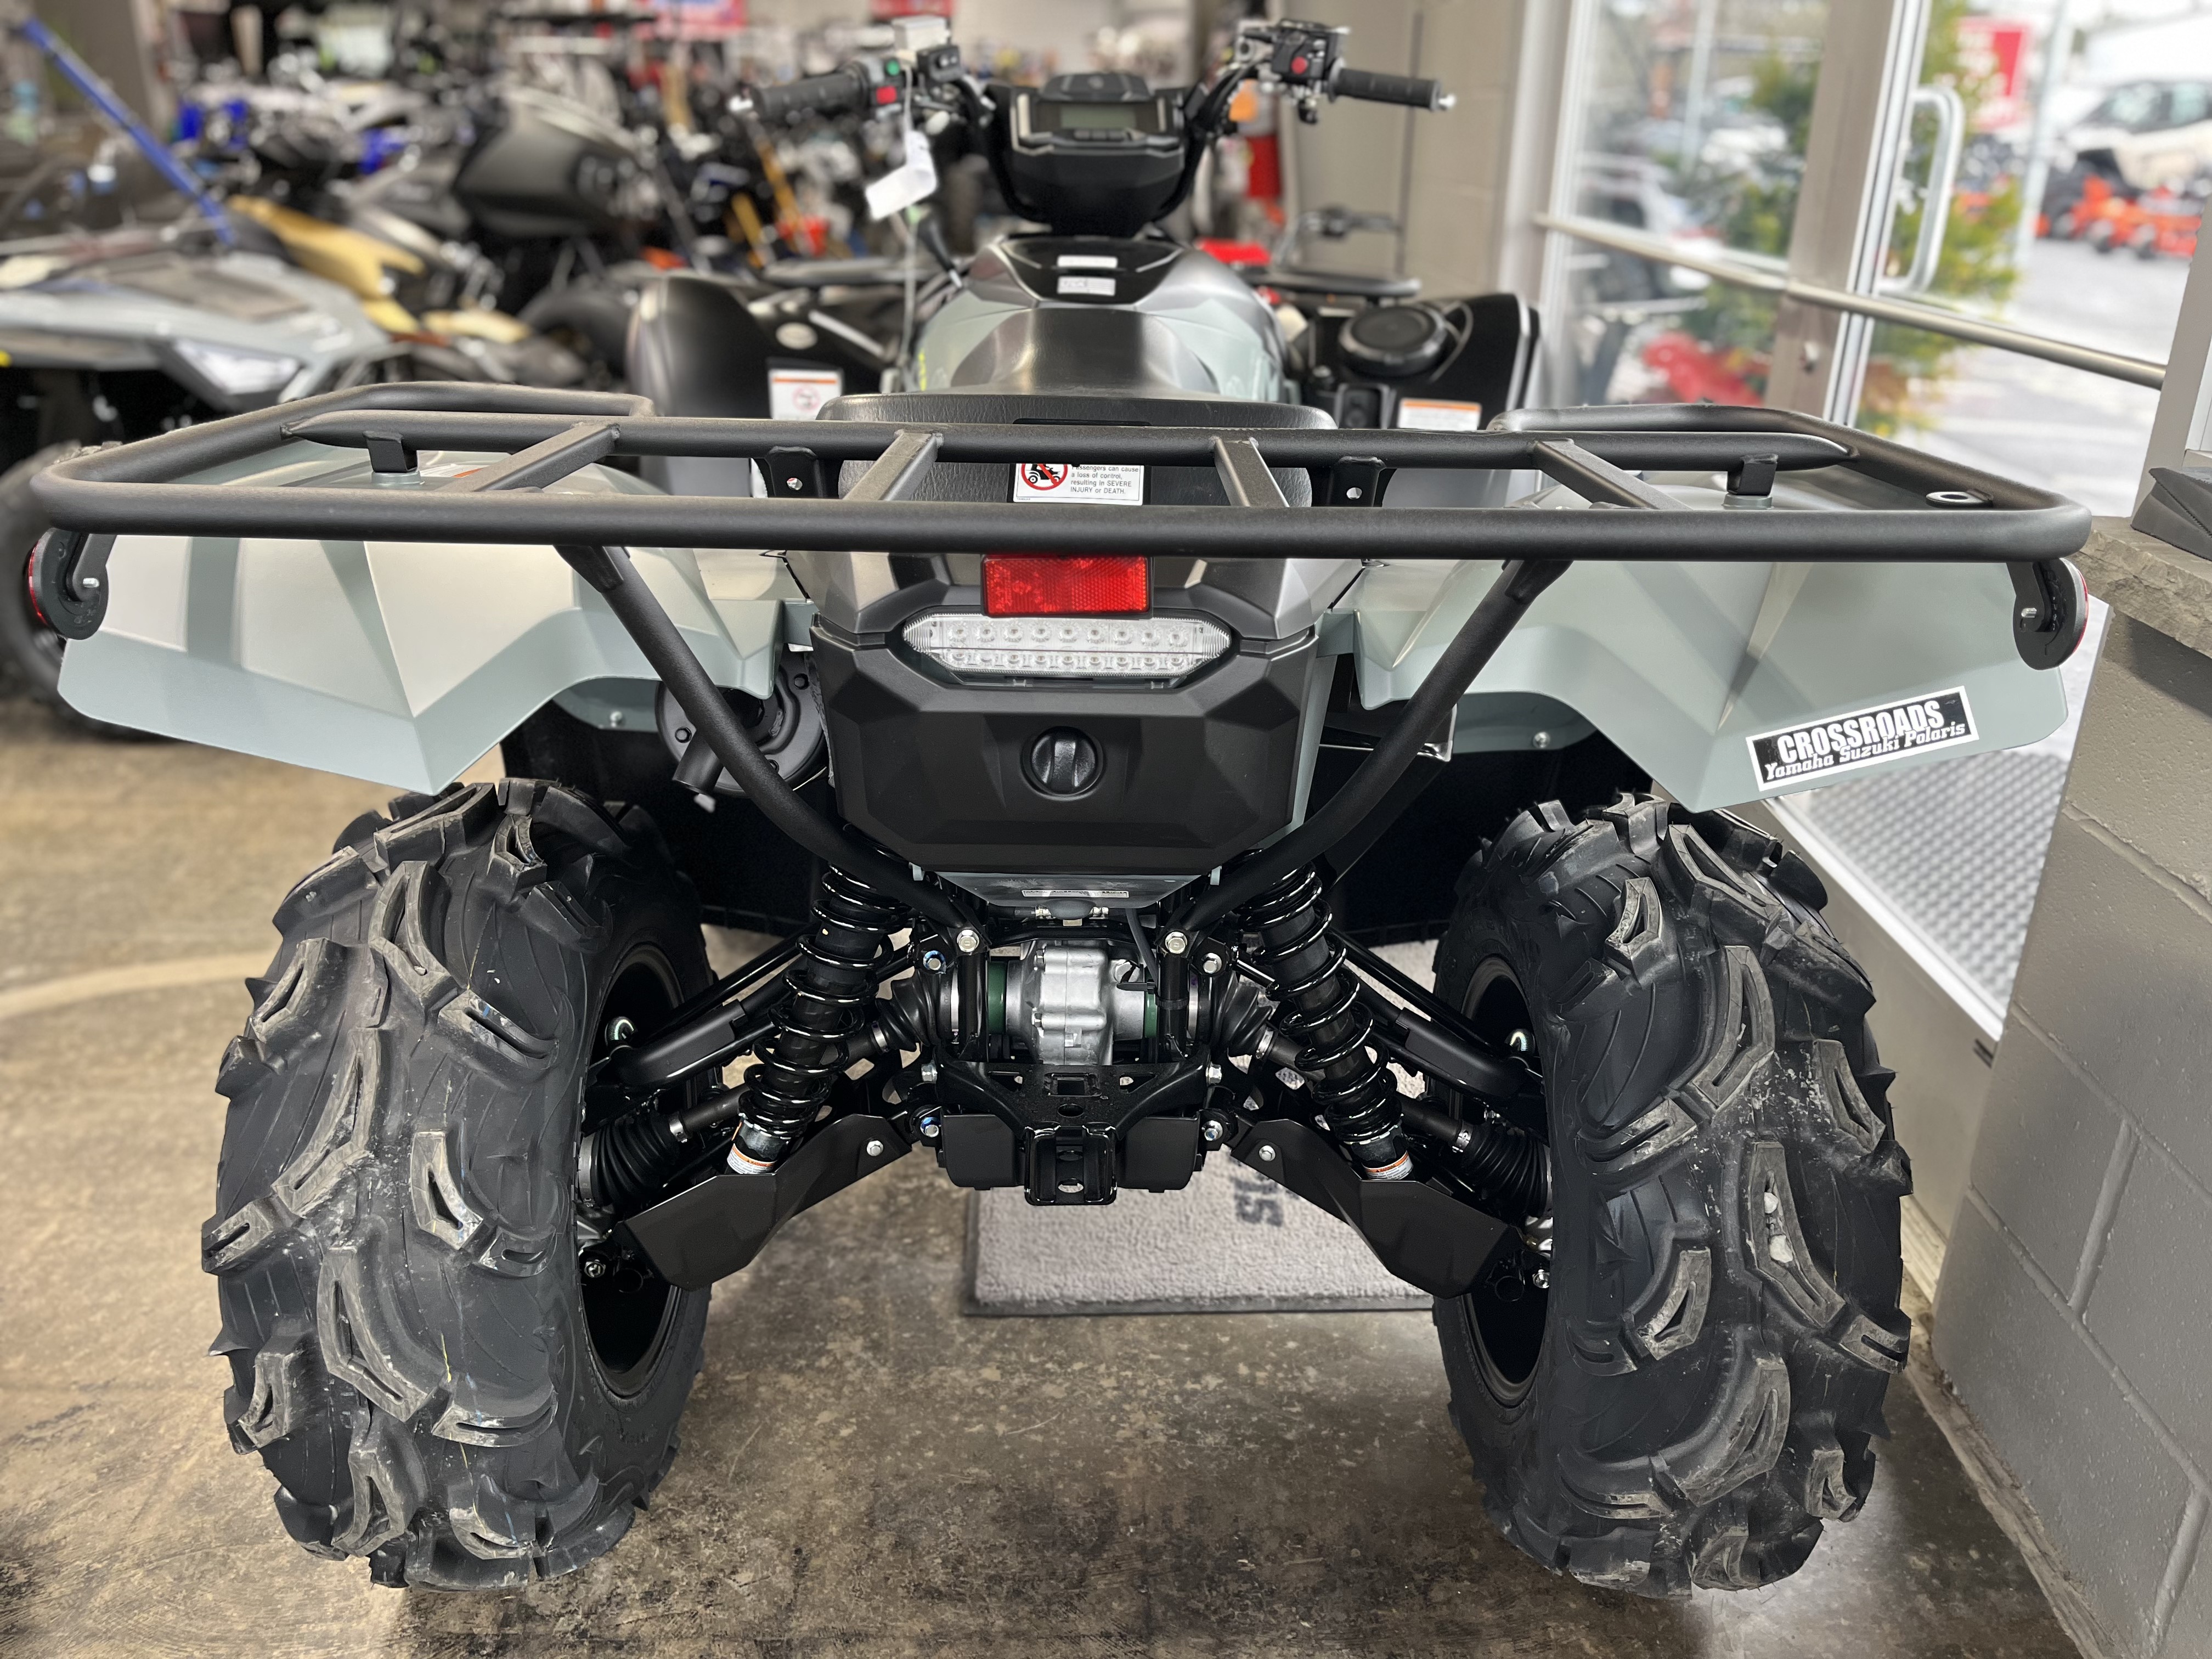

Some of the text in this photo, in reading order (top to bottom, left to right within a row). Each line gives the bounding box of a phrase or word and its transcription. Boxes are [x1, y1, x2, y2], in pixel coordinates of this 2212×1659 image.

[1764, 721, 1965, 780] Yamaha Suzuki Polaris
[1778, 701, 1944, 763] CROSSROADS
